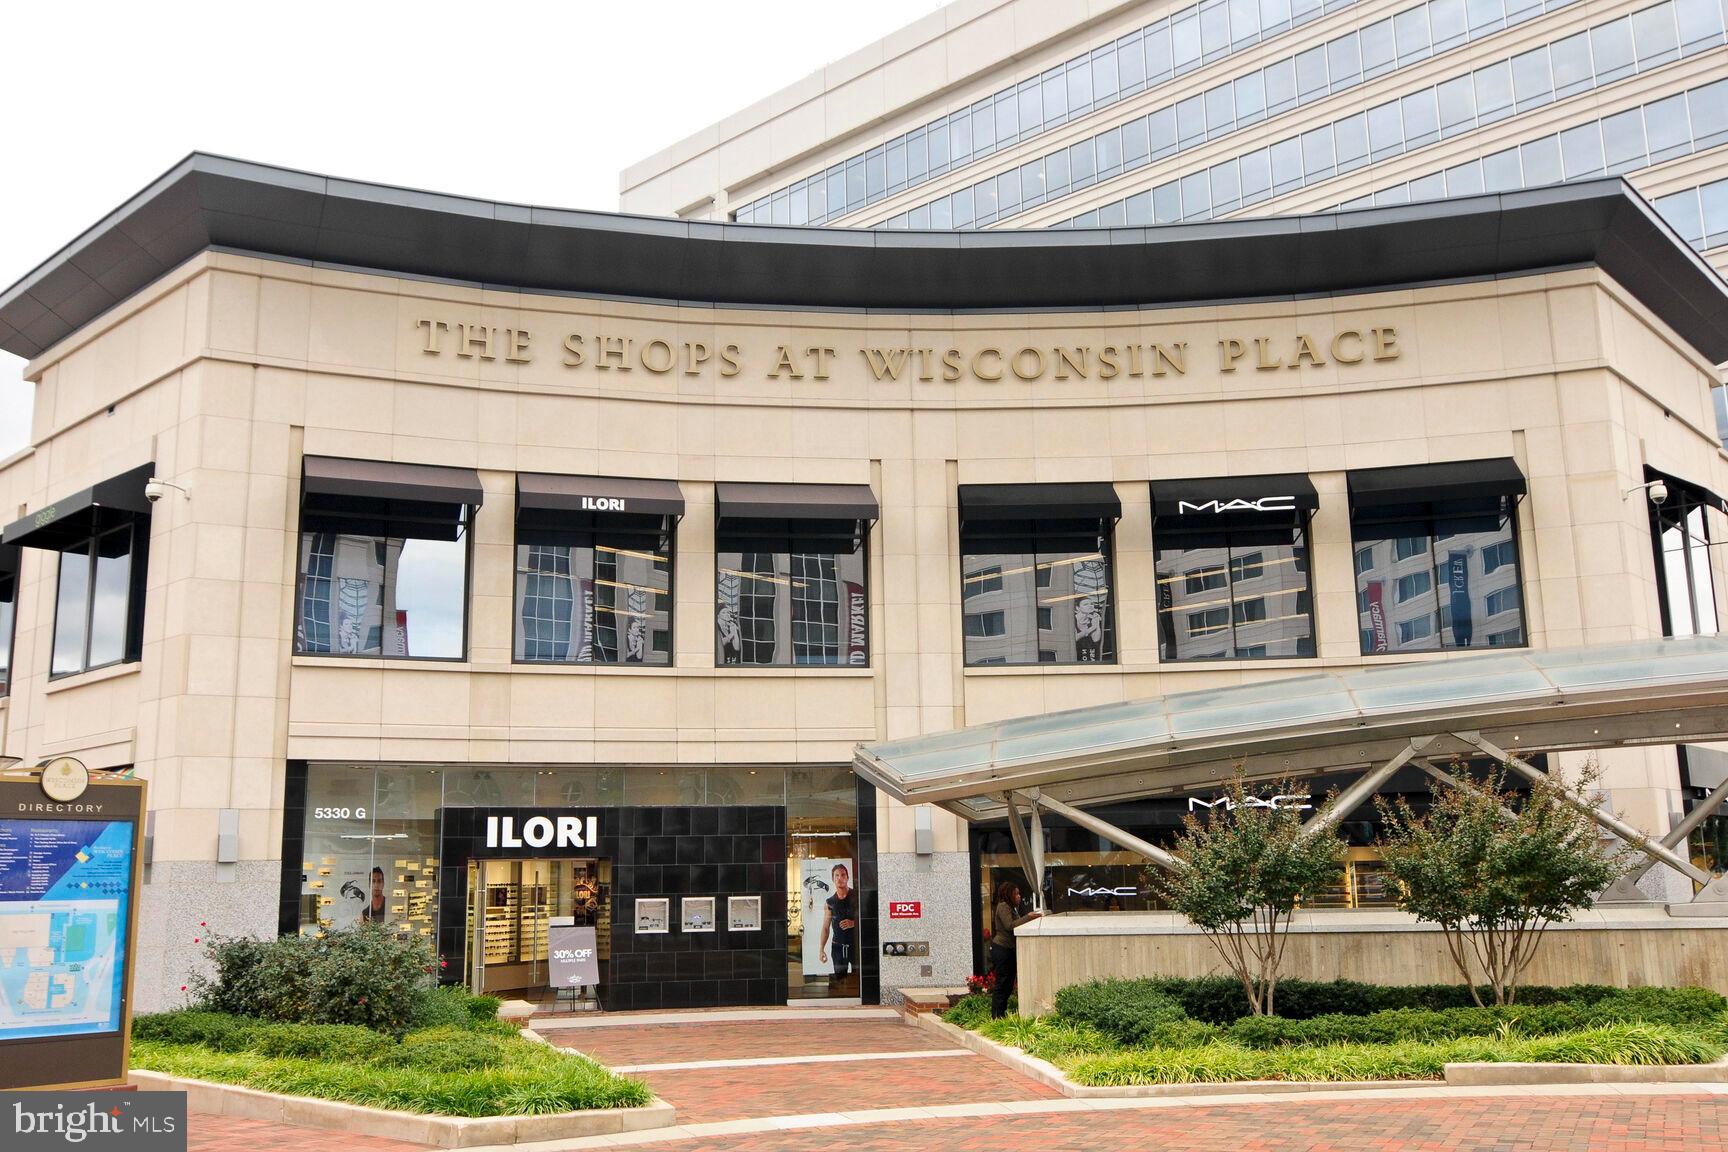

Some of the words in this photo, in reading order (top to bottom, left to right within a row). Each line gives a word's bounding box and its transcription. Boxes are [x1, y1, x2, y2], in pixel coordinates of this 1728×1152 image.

[417, 319, 533, 364] THE
[562, 334, 743, 377] SHOPS
[766, 346, 836, 380] AT
[860, 341, 1189, 382] WISCONSIN
[1218, 326, 1401, 373] PLACE
[581, 496, 625, 511] ILORI
[18, 803, 103, 813] DIRECTORY
[314, 808, 351, 819] 5330
[355, 808, 366, 819] G
[486, 816, 598, 848] ILORI
[896, 904, 915, 913] FDC
[553, 949, 574, 959] 30%
[575, 948, 593, 958] OFF
